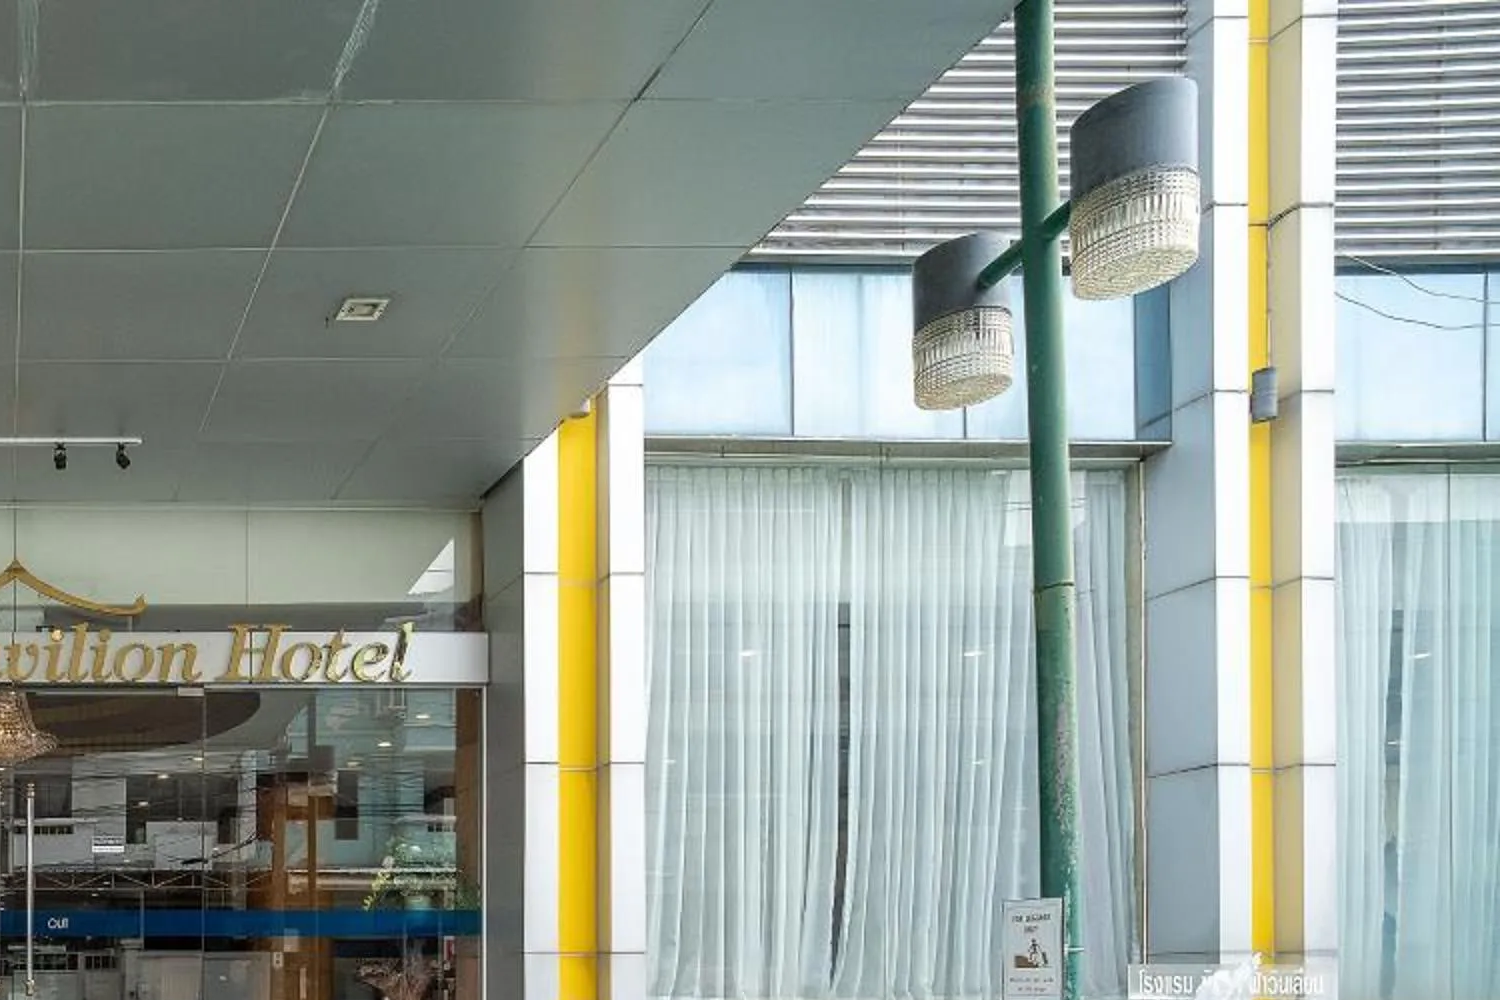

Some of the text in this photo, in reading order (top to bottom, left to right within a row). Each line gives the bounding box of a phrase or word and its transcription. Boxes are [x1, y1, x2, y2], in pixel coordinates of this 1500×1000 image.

[216, 621, 414, 684] Hotel
[47, 917, 69, 929] OUT
[1138, 969, 1194, 995] โรงแรม
